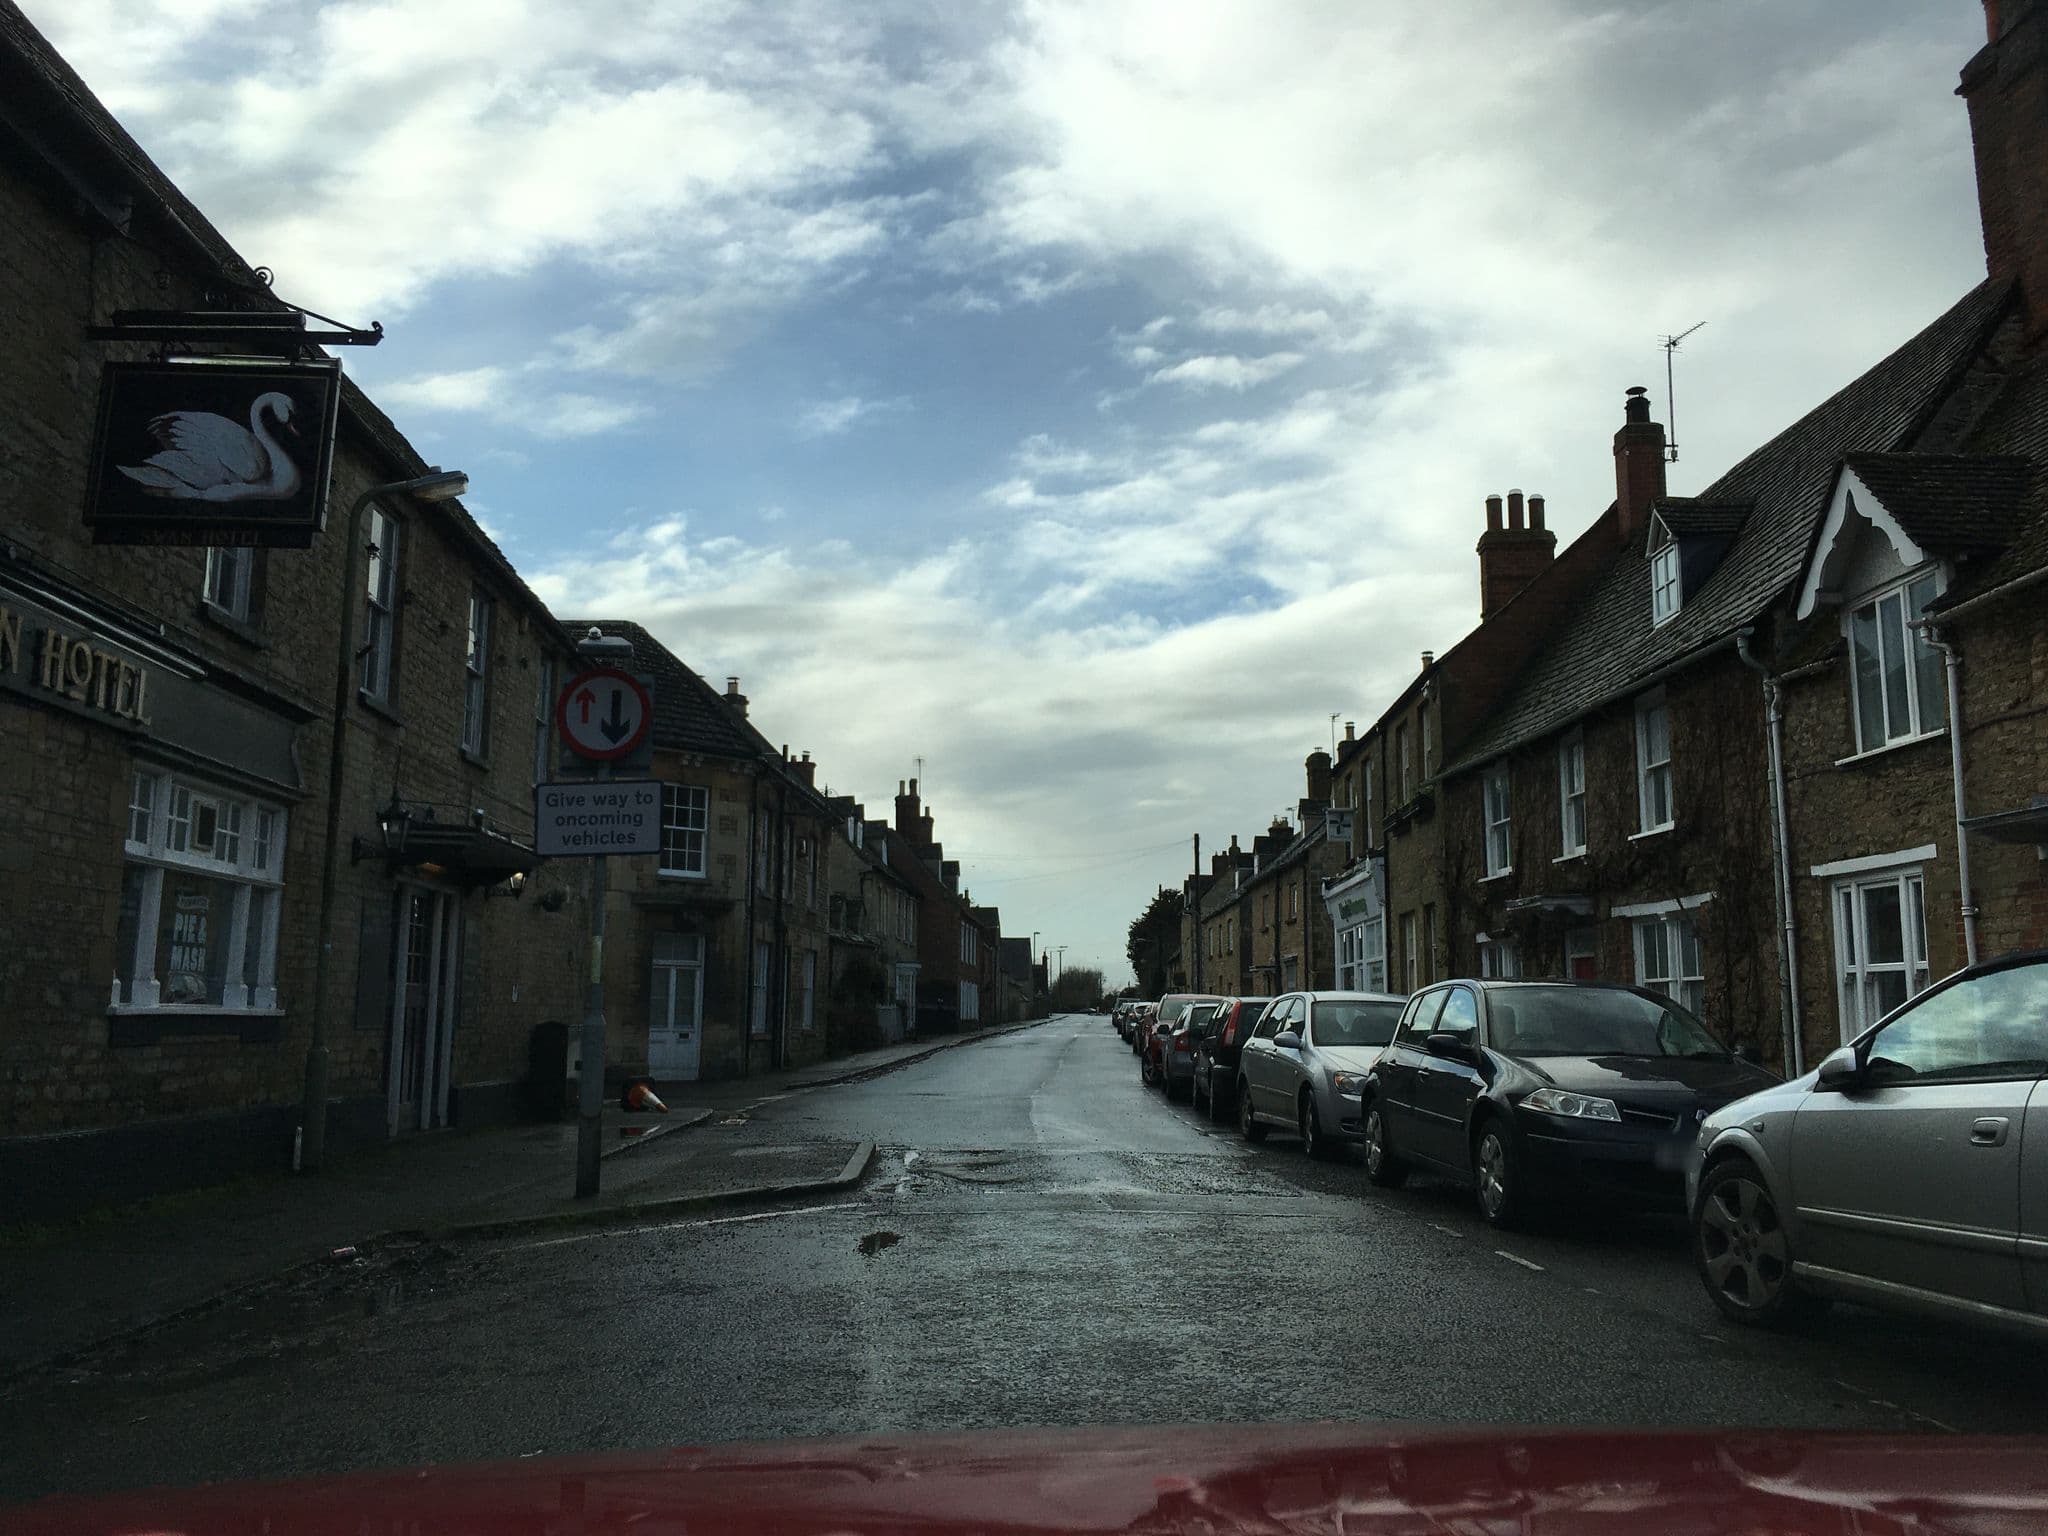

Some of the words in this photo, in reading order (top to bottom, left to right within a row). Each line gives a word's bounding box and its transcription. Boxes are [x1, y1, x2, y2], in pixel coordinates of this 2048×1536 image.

[201, 529, 262, 546] HOTEL
[40, 626, 152, 727] HOTEL
[545, 792, 585, 808] Give
[592, 793, 628, 808] way
[634, 789, 654, 805] to
[555, 810, 643, 827] oncoming
[562, 831, 636, 846] vehicles
[174, 912, 197, 944] PIE
[170, 944, 207, 971] MASH
